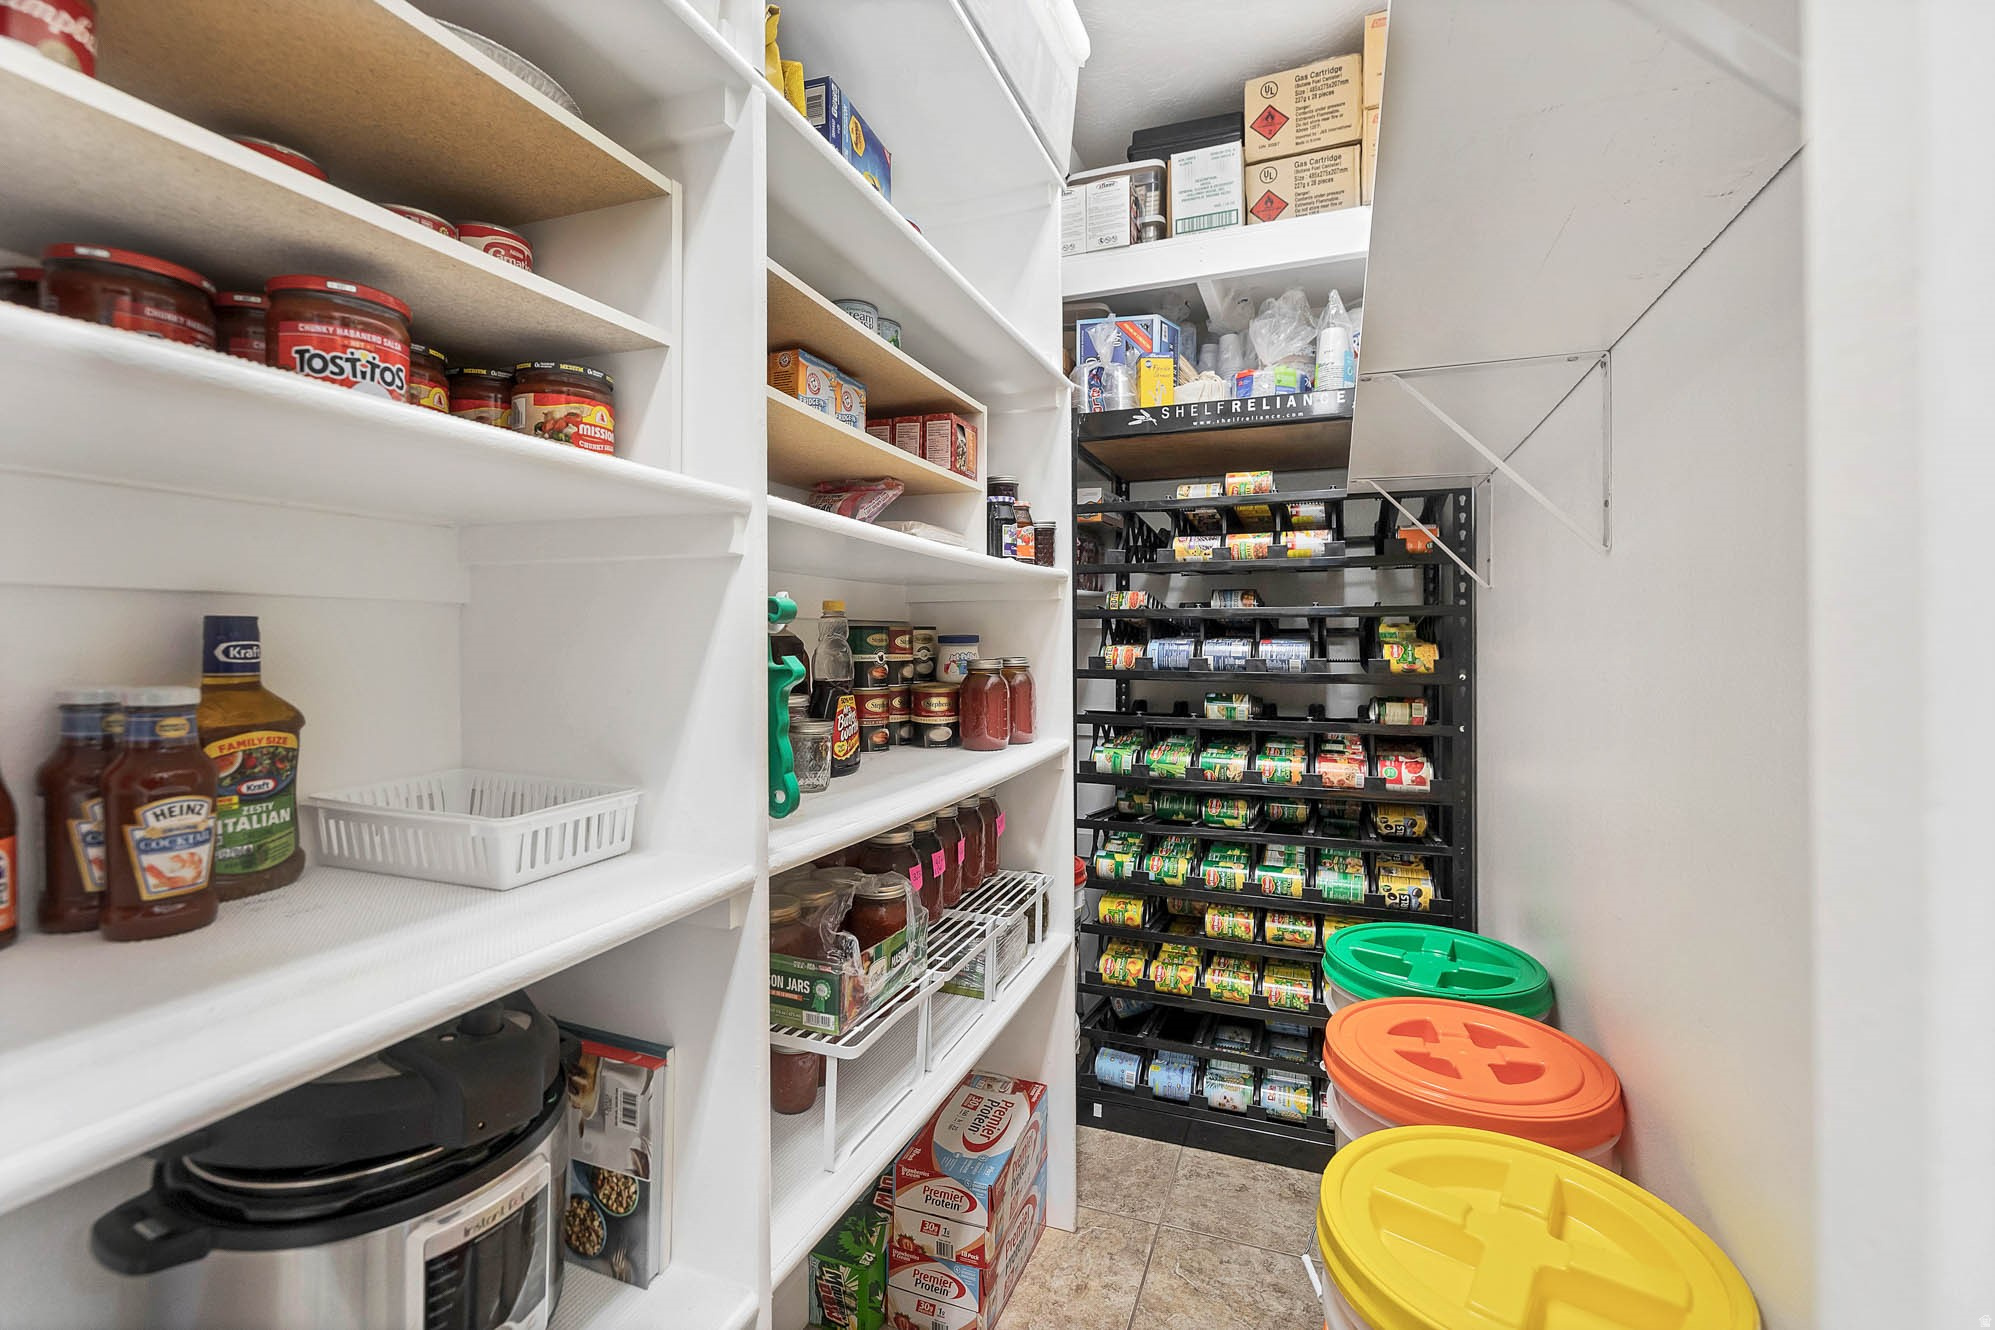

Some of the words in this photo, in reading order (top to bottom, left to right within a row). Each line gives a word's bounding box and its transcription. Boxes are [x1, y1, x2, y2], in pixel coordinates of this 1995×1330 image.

[1294, 74, 1309, 82] Gas
[1310, 65, 1343, 79] Cartridge
[1294, 89, 1306, 97] Size
[1318, 90, 1335, 99] pieces
[1294, 161, 1308, 169] Gas
[1309, 154, 1342, 166] Cartridge
[1317, 177, 1334, 186] pieces
[559, 363, 584, 373] MEDIUM
[218, 737, 262, 754] FAMILY
[264, 734, 288, 747] SIZE
[245, 780, 270, 793] Kraft
[151, 803, 206, 823] HEINZ
[242, 802, 275, 815] ZESTY
[217, 807, 292, 834] ITALIAN
[138, 830, 210, 850] COCKTAIL
[785, 977, 811, 994] JARS
[968, 1098, 1000, 1134] Protein
[980, 1099, 1015, 1141] Premier
[922, 1185, 964, 1204] Premier
[924, 1194, 960, 1211] Protein
[923, 1221, 938, 1232] 30g
[1005, 1209, 1031, 1259] Premier
[968, 1252, 979, 1260] Pack
[912, 1268, 953, 1289] Premier
[914, 1277, 949, 1297] Protein
